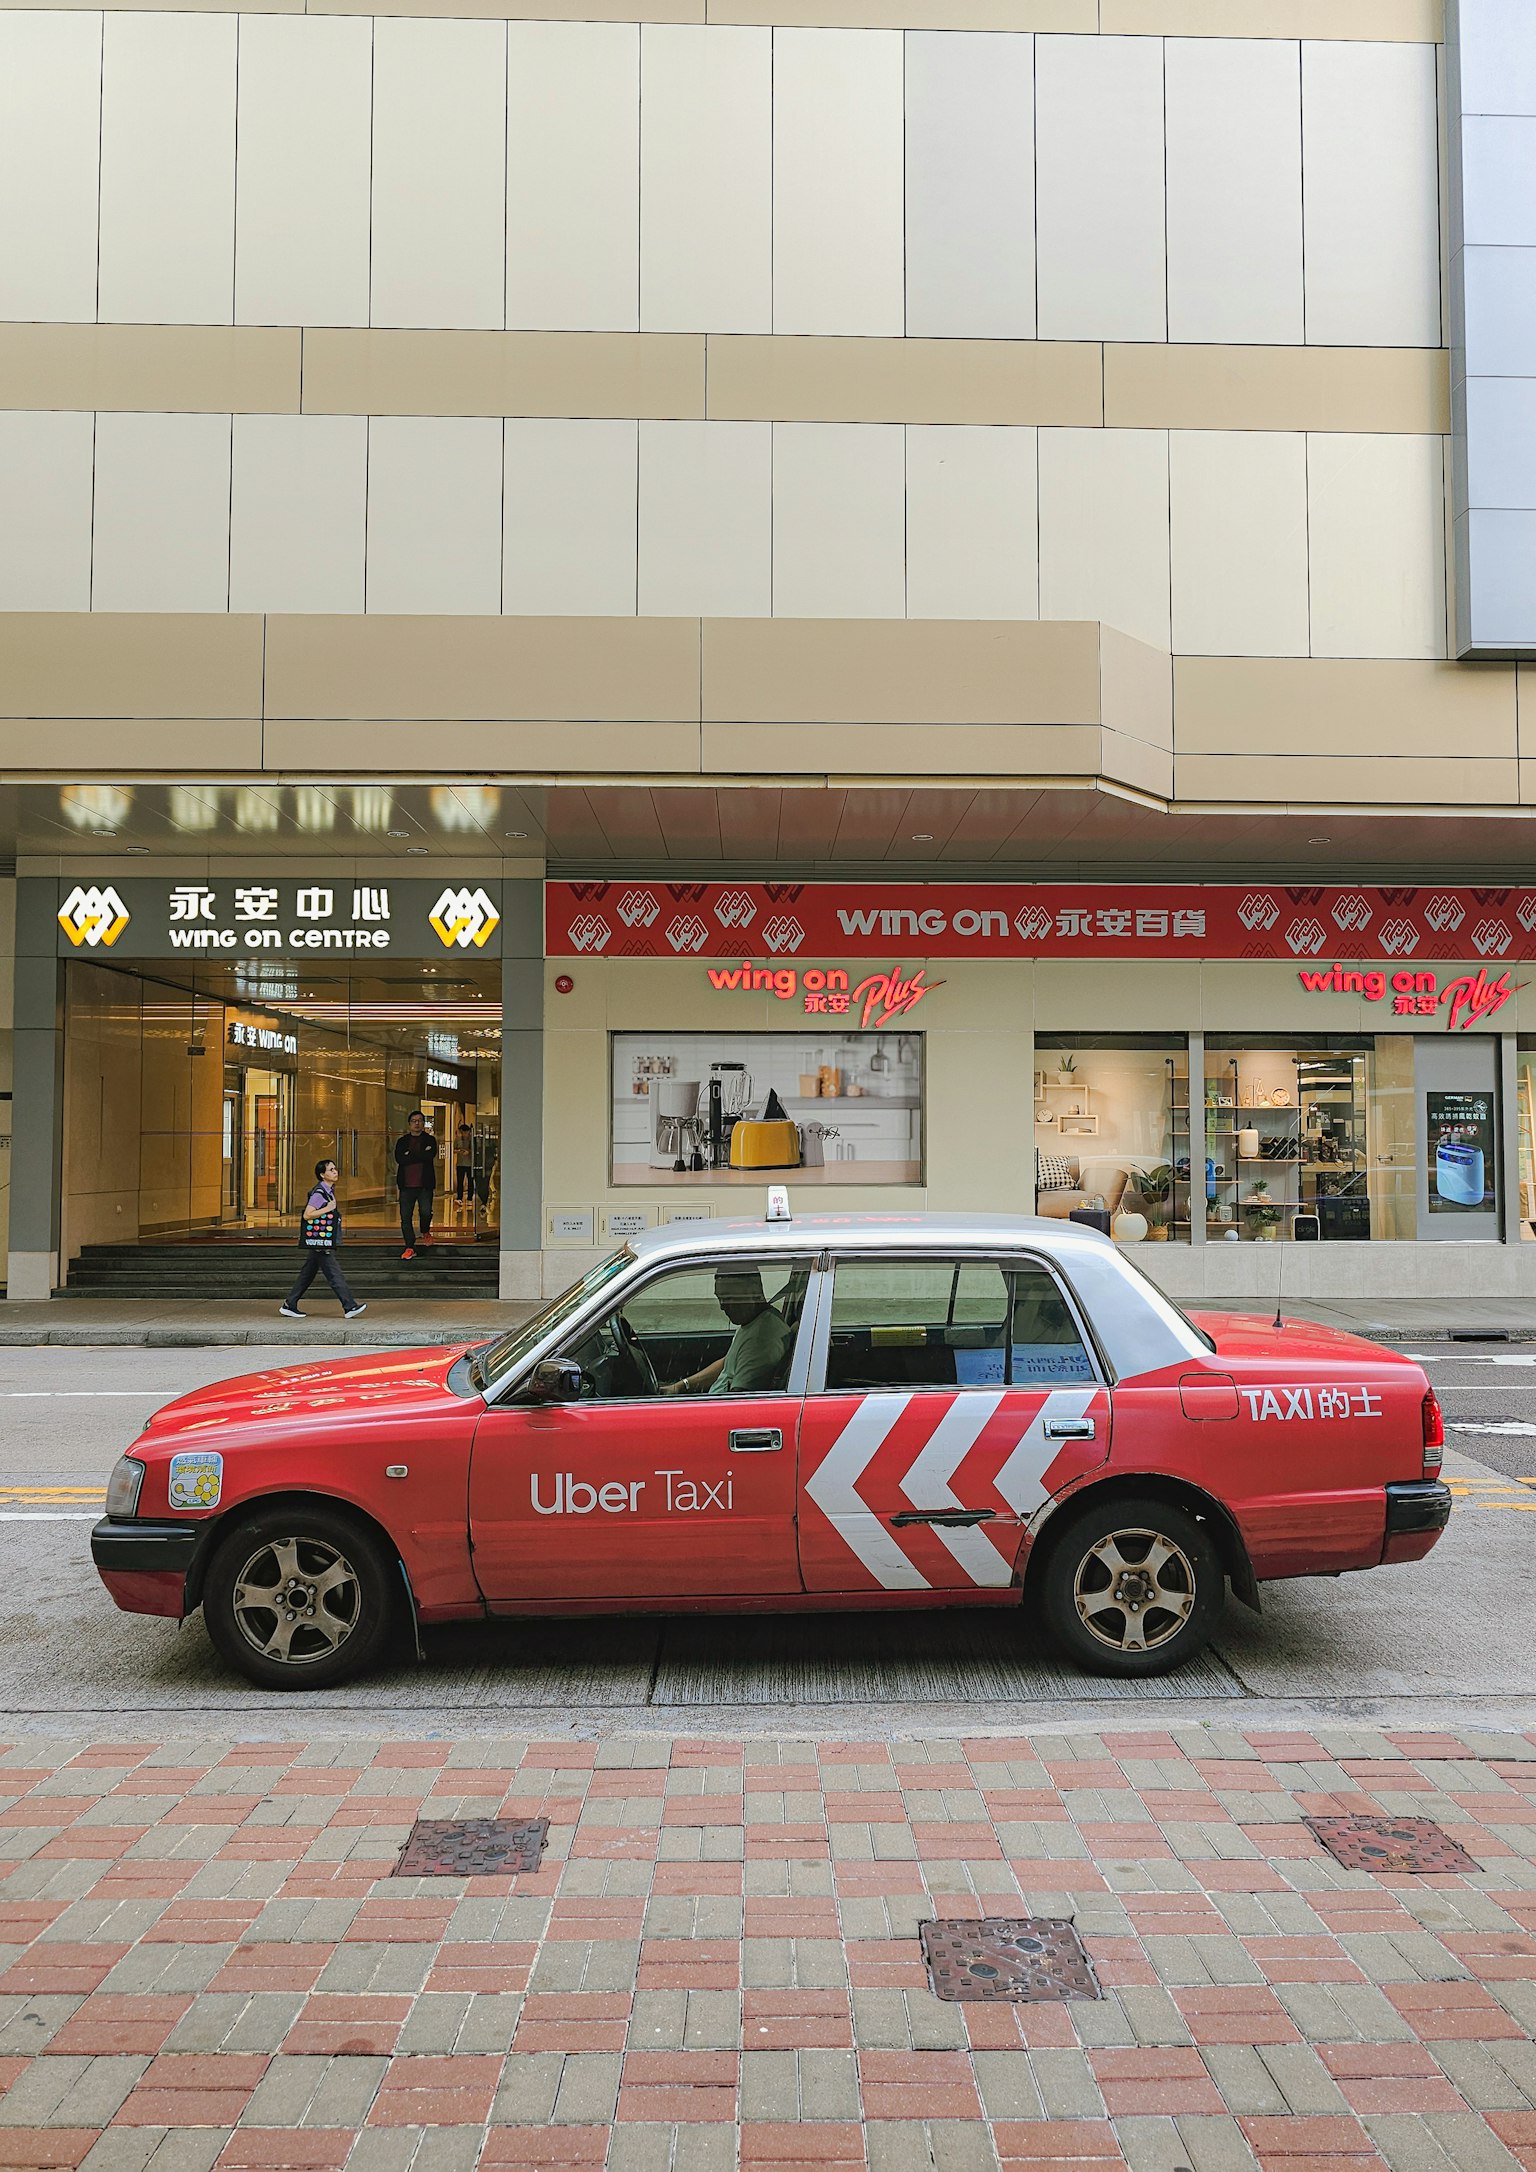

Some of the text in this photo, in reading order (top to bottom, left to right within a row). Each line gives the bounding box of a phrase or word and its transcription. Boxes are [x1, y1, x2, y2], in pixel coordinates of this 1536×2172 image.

[169, 887, 390, 921] 永安中心
[1055, 908, 1206, 937] 永安百貨
[707, 961, 797, 999] wing
[803, 969, 848, 990] on
[1299, 963, 1386, 1000] wing
[1392, 971, 1437, 992] on
[804, 993, 850, 1014] 永安
[1394, 995, 1438, 1015] 永安
[233, 1022, 257, 1047] 永安
[1241, 1387, 1383, 1421] TAXI 的士
[530, 1470, 733, 1515] Uber Taxi
